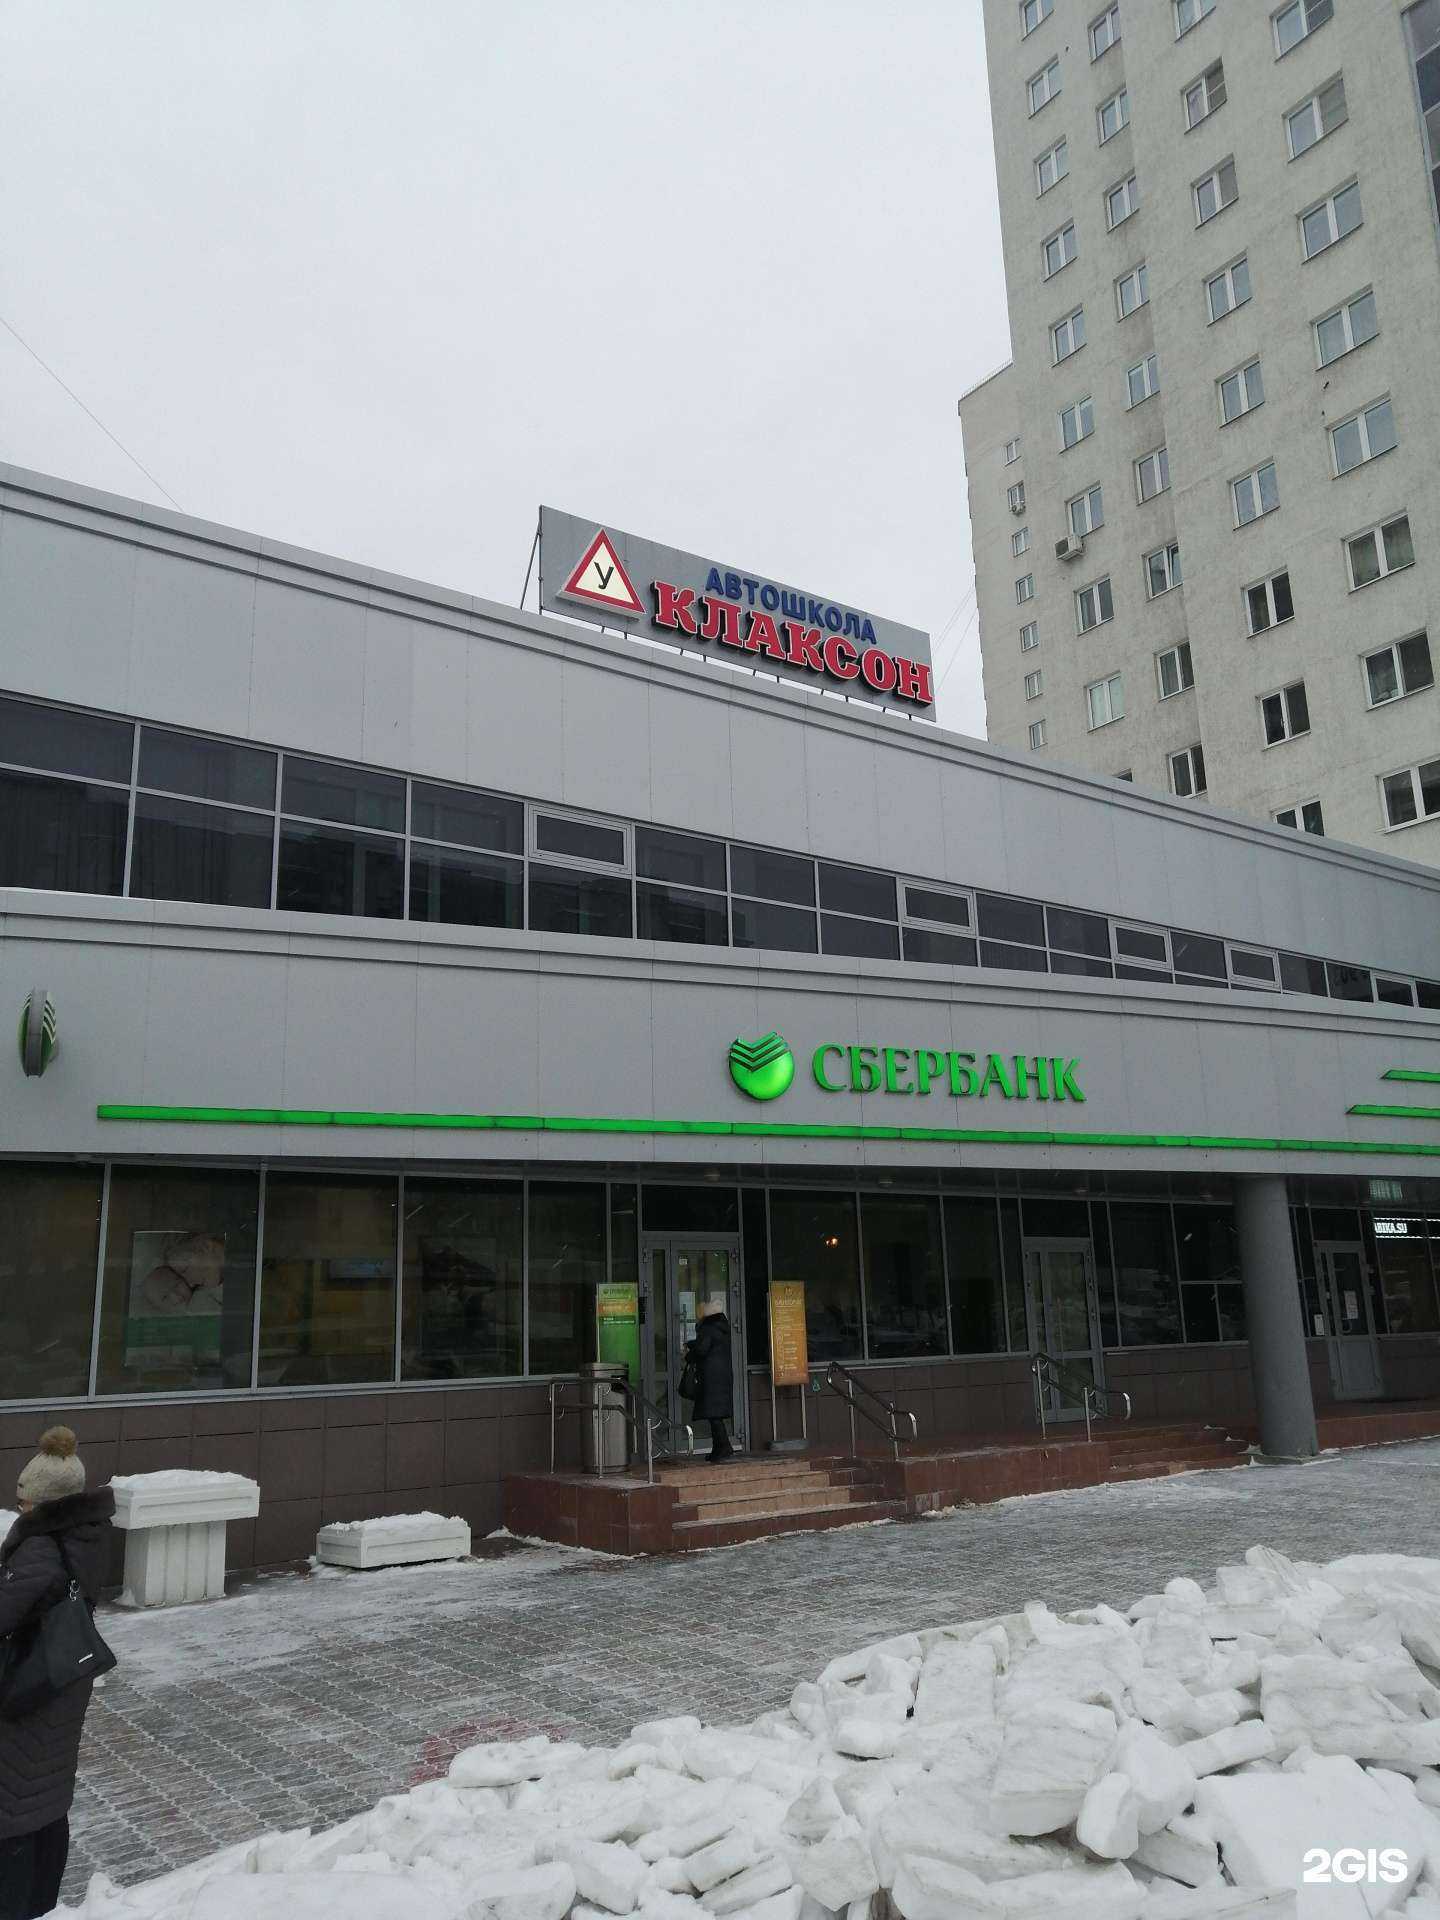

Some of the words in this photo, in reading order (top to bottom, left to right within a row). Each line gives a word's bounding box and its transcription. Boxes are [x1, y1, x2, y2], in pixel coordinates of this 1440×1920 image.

[594, 561, 615, 590] У
[705, 566, 878, 645] АВТОШКОЛА
[651, 579, 934, 706] КЛАКСОН
[811, 1042, 1087, 1102] СБЕРБАНК
